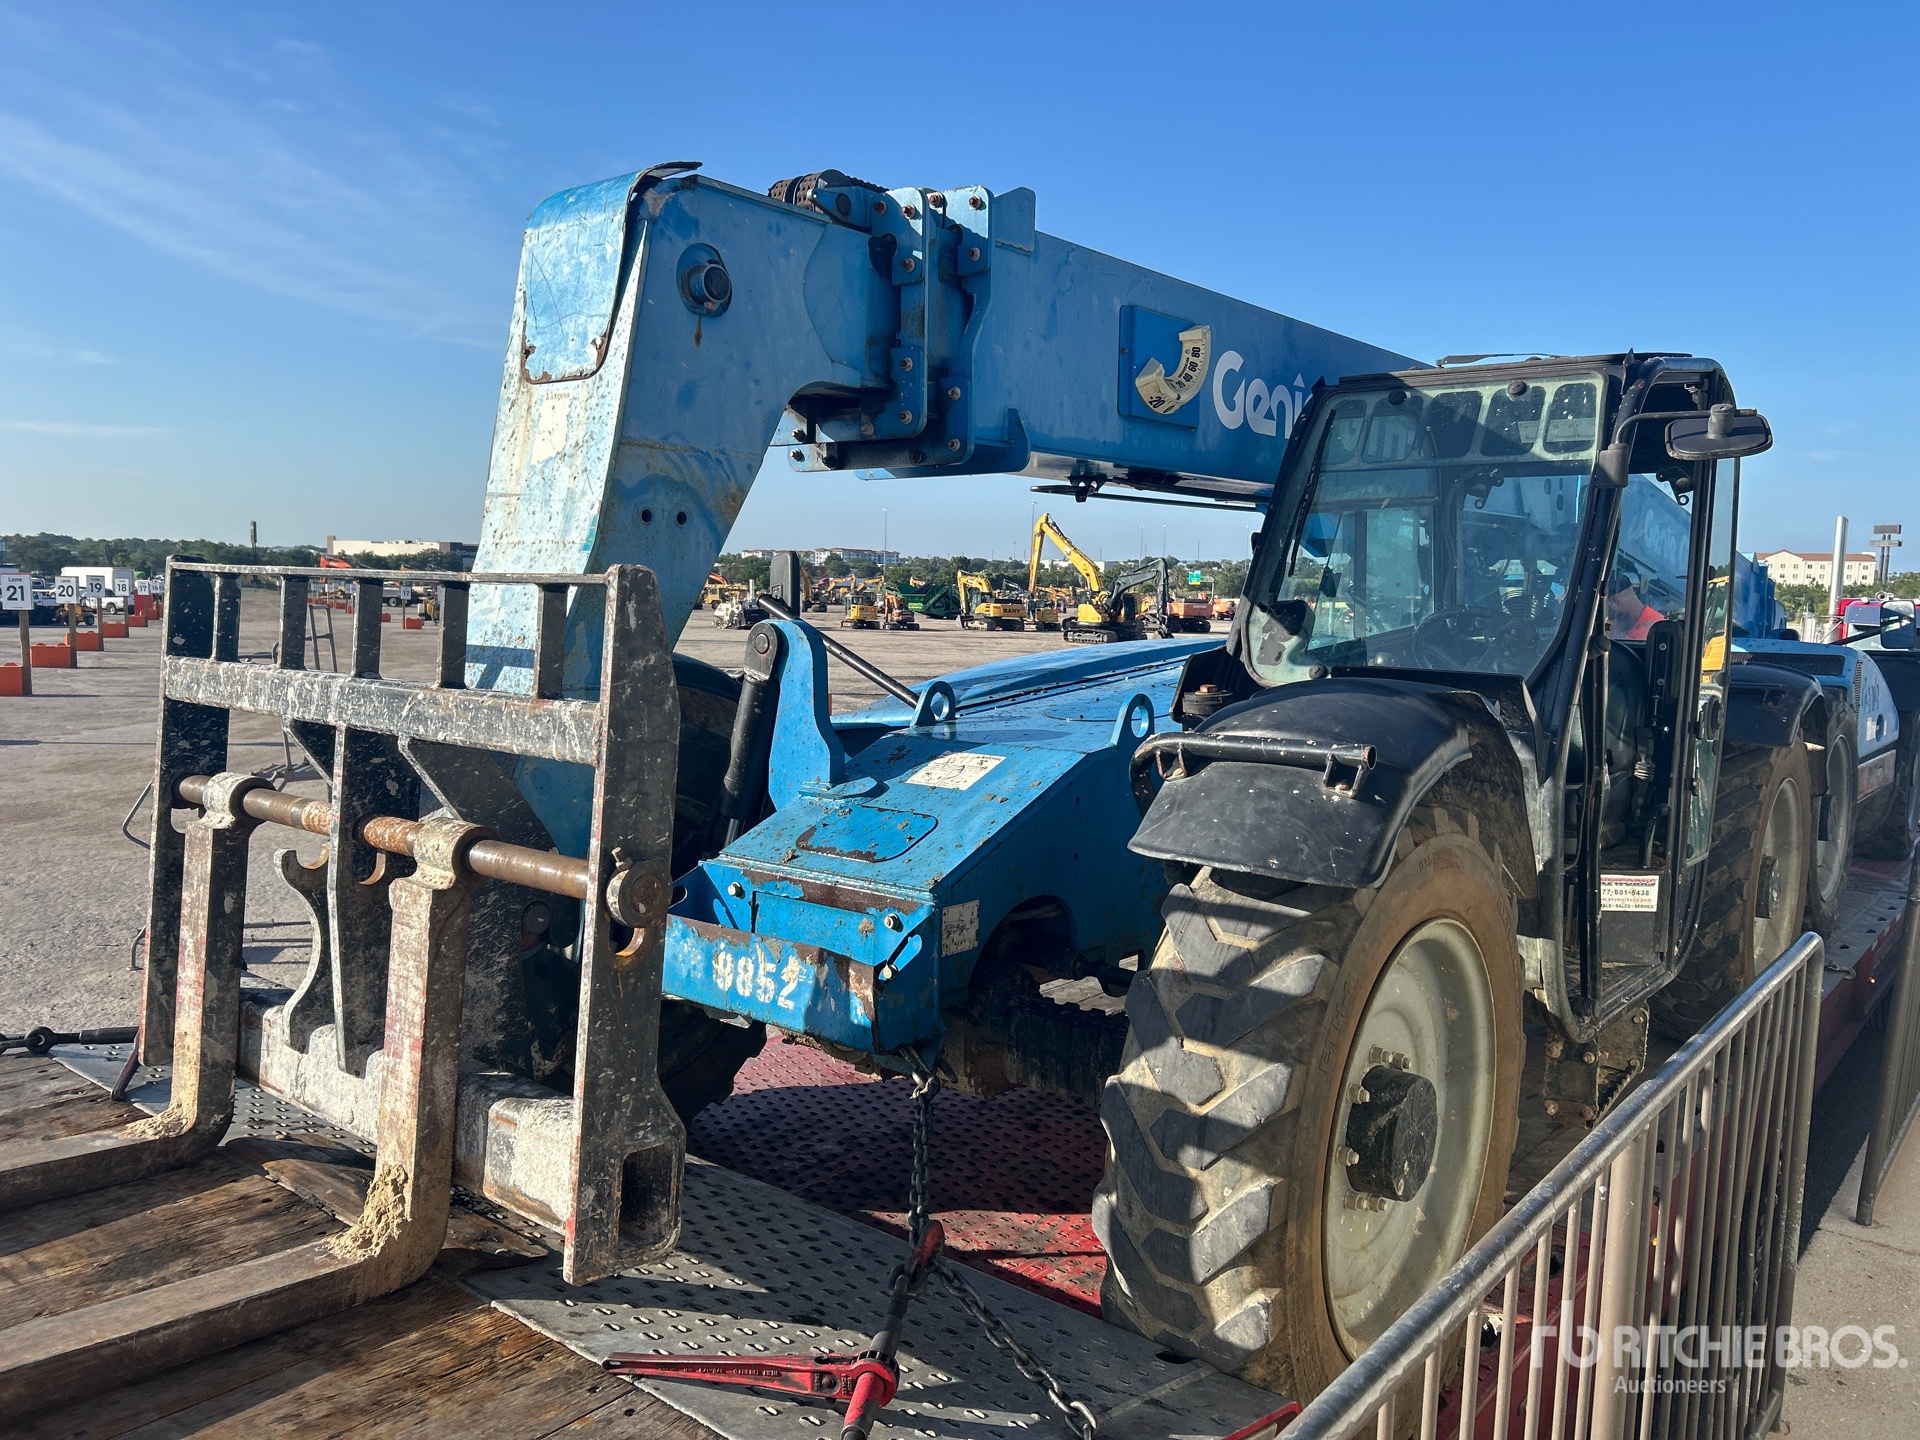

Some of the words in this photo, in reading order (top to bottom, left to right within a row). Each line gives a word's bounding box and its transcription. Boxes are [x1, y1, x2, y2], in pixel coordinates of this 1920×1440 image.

[1191, 347, 1201, 358] 80
[1188, 361, 1198, 372] 60
[1183, 373, 1193, 382] 40
[1213, 350, 1314, 440] Geni
[6, 585, 25, 601] 21
[58, 585, 74, 597] 20
[89, 583, 102, 593] 19
[117, 584, 127, 592] 18
